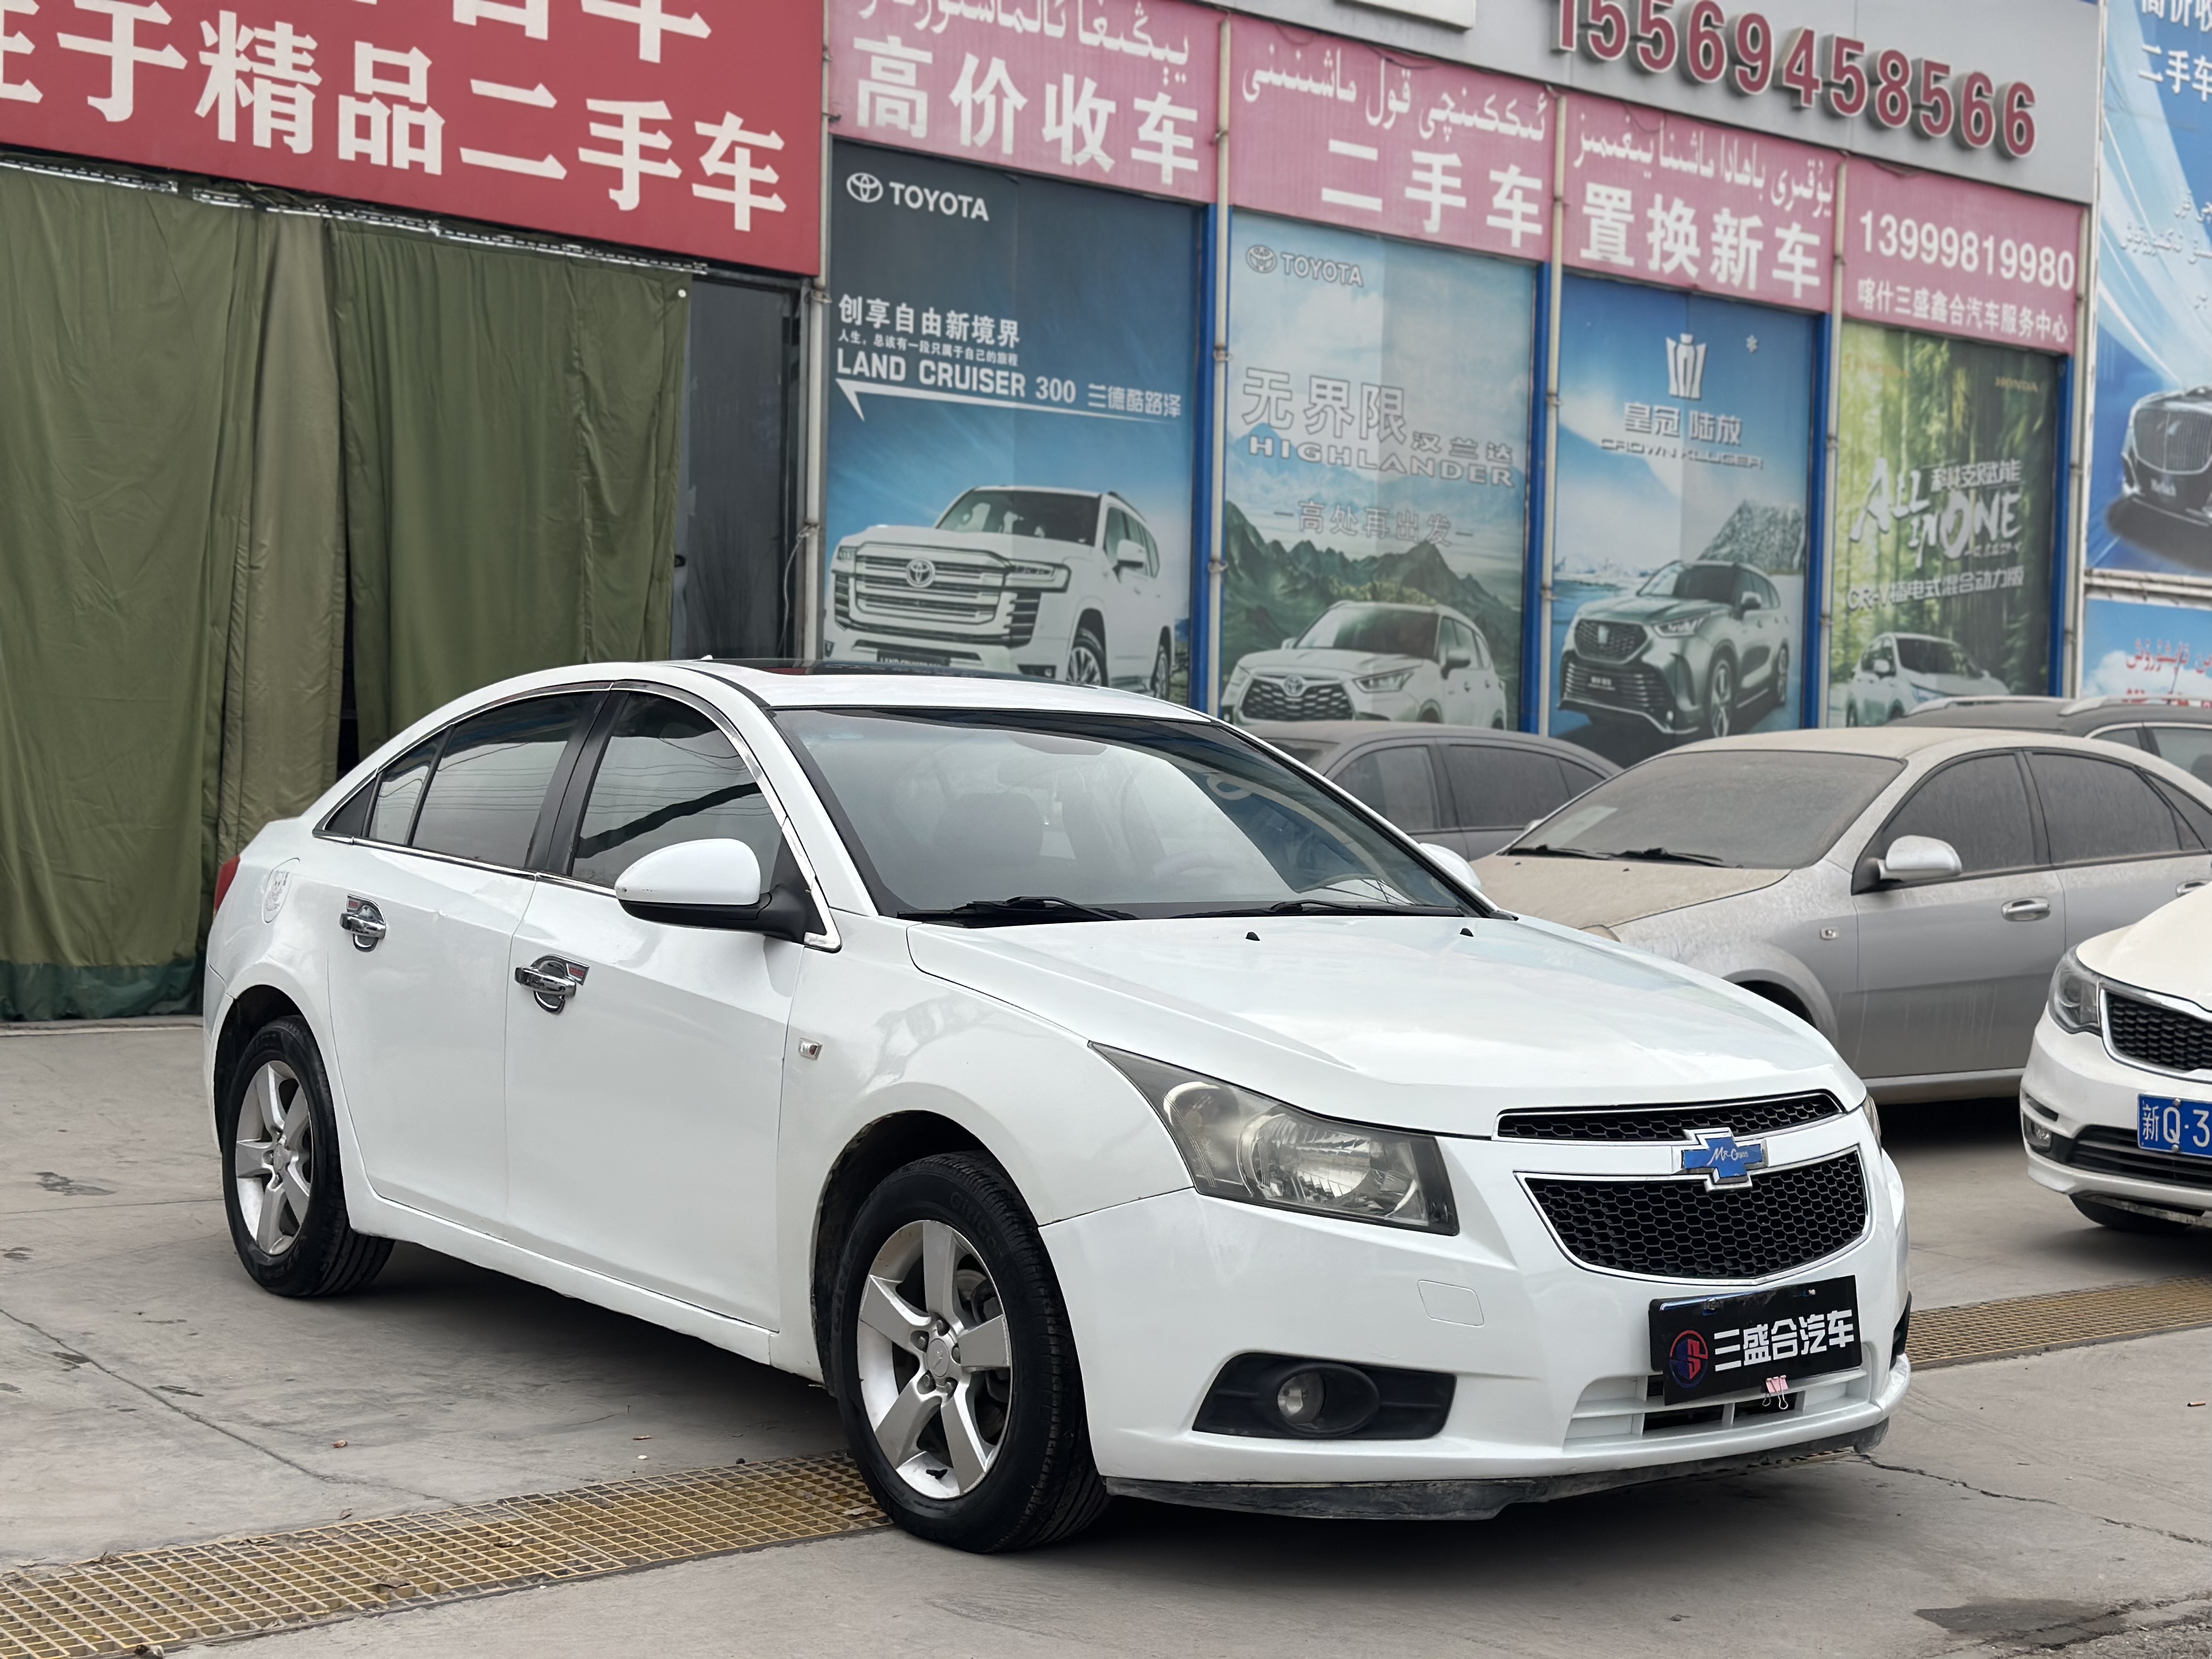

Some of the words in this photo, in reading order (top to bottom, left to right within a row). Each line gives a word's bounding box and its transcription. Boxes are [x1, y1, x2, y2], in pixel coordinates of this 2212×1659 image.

[1560, 0, 2036, 157] 15569458566
[2138, 44, 2212, 101] 二手车
[853, 35, 1198, 185] 高价收车
[889, 182, 989, 222] TOYOTA
[1321, 139, 1543, 249] 二手车
[1281, 252, 1364, 287] TOYOTA
[1580, 182, 1820, 299] 置换新车
[1860, 211, 2075, 291] 13999819980
[839, 294, 1020, 349] 创享自由新境界
[1858, 278, 2069, 344] 喀什三盛鑫合汽车服务中心
[837, 348, 906, 382] LAND
[918, 359, 1026, 398] CRUISER
[1035, 376, 1076, 404] 300
[1242, 366, 1407, 444] 无界限
[1410, 431, 1513, 465] 汉兰达
[1624, 402, 1681, 438] 皇冠
[1689, 410, 1742, 447] 陆放
[1249, 435, 1516, 488] HIGHLANDER
[1849, 458, 1931, 543] ALL
[1940, 488, 2025, 560] ONE
[1714, 1310, 1854, 1372] 三盛合汽车
